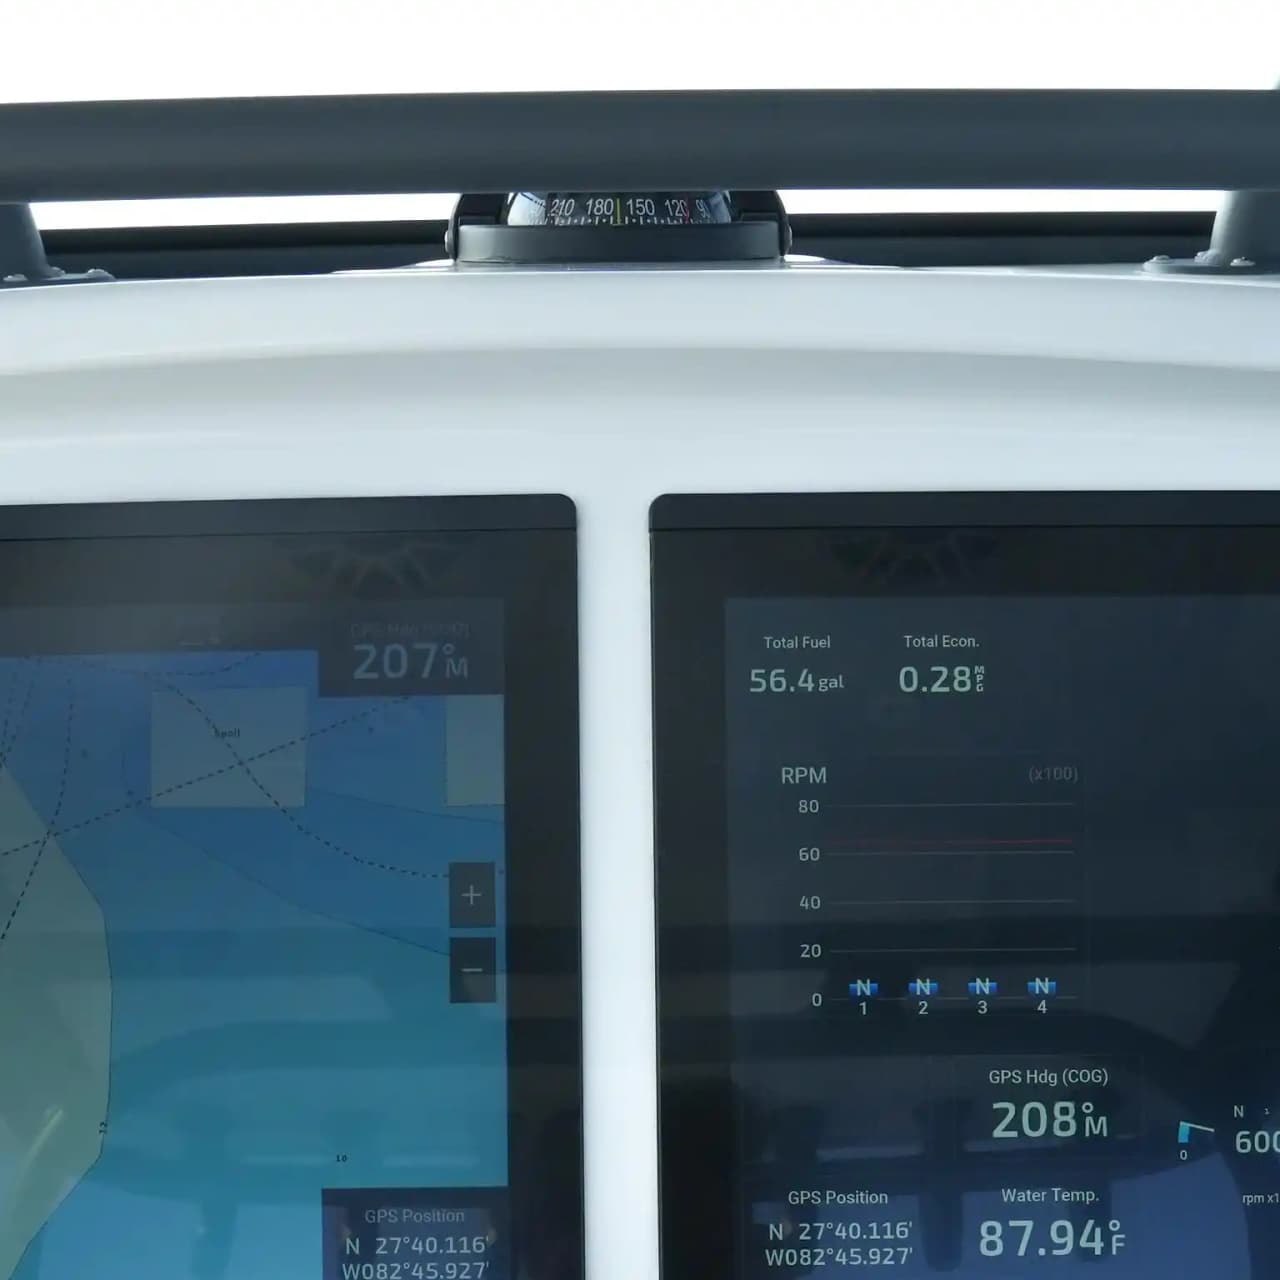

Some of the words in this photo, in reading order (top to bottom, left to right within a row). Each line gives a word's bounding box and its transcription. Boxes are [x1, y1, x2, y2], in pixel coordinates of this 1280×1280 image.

[585, 198, 614, 216] 180
[625, 198, 655, 216] 150
[664, 198, 689, 216] 120
[763, 635, 798, 649] Total
[801, 635, 832, 649] Fuel
[903, 634, 939, 648] Total
[941, 634, 981, 648] Econ.
[780, 766, 828, 784] RPM
[798, 800, 820, 814] 80
[798, 848, 821, 862] 60
[799, 896, 822, 910] 40
[799, 944, 823, 959] 20
[918, 1001, 929, 1015] 2
[977, 1000, 988, 1015] 3
[1036, 1000, 1048, 1014] 4
[988, 1069, 1022, 1085] GPS
[1026, 1069, 1058, 1087] Hdg
[1062, 1067, 1111, 1087] (COG)
[1233, 1105, 1244, 1118] N
[788, 1190, 821, 1205] GPS
[825, 1189, 889, 1205] Position
[1001, 1188, 1047, 1203] Water
[1051, 1187, 1100, 1206] Temp.
[1242, 1194, 1265, 1205] rpm
[364, 1208, 398, 1224] GPS
[402, 1207, 465, 1223] Position
[768, 1223, 784, 1241] N
[345, 1238, 360, 1255] N
